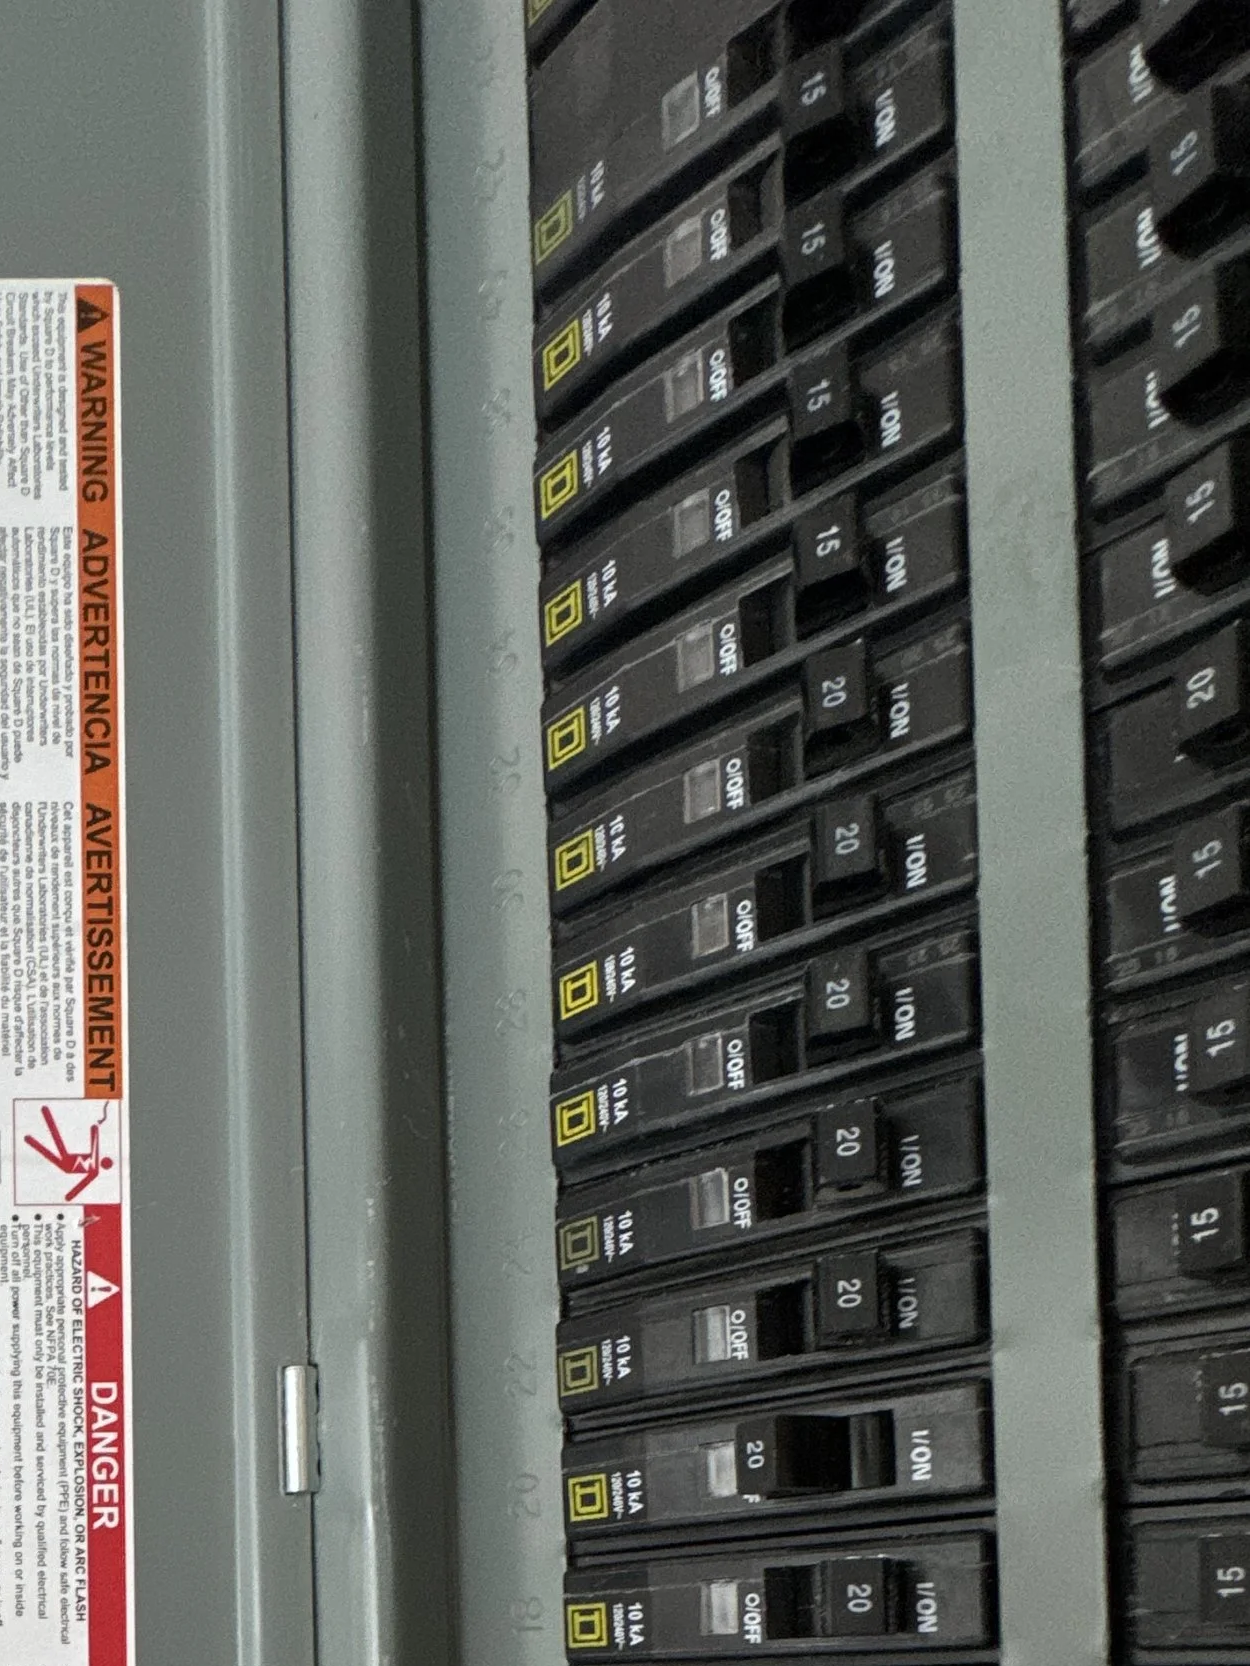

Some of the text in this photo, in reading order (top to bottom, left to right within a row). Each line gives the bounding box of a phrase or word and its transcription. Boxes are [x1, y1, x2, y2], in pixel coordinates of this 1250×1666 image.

[802, 73, 826, 105] 15
[802, 223, 825, 254] 15
[1173, 305, 1200, 347] 15
[808, 380, 830, 411] 15
[82, 341, 108, 502] WARNING
[1186, 481, 1214, 522] 15
[817, 526, 840, 556] 15
[83, 529, 112, 775] ADVERTENCIA
[822, 677, 846, 707] 20
[1187, 668, 1214, 708] 20
[836, 823, 859, 854] 20
[1193, 841, 1221, 878] 15
[86, 804, 116, 1093] AVERTISSEMENT
[827, 979, 850, 1008] 20
[1207, 1020, 1235, 1056] 15
[837, 1127, 860, 1156] 20
[1191, 1208, 1218, 1241] 15
[838, 1279, 861, 1307] 20
[92, 1382, 119, 1529] DANGER
[747, 1441, 764, 1468] 20
[848, 1585, 872, 1612] 20
